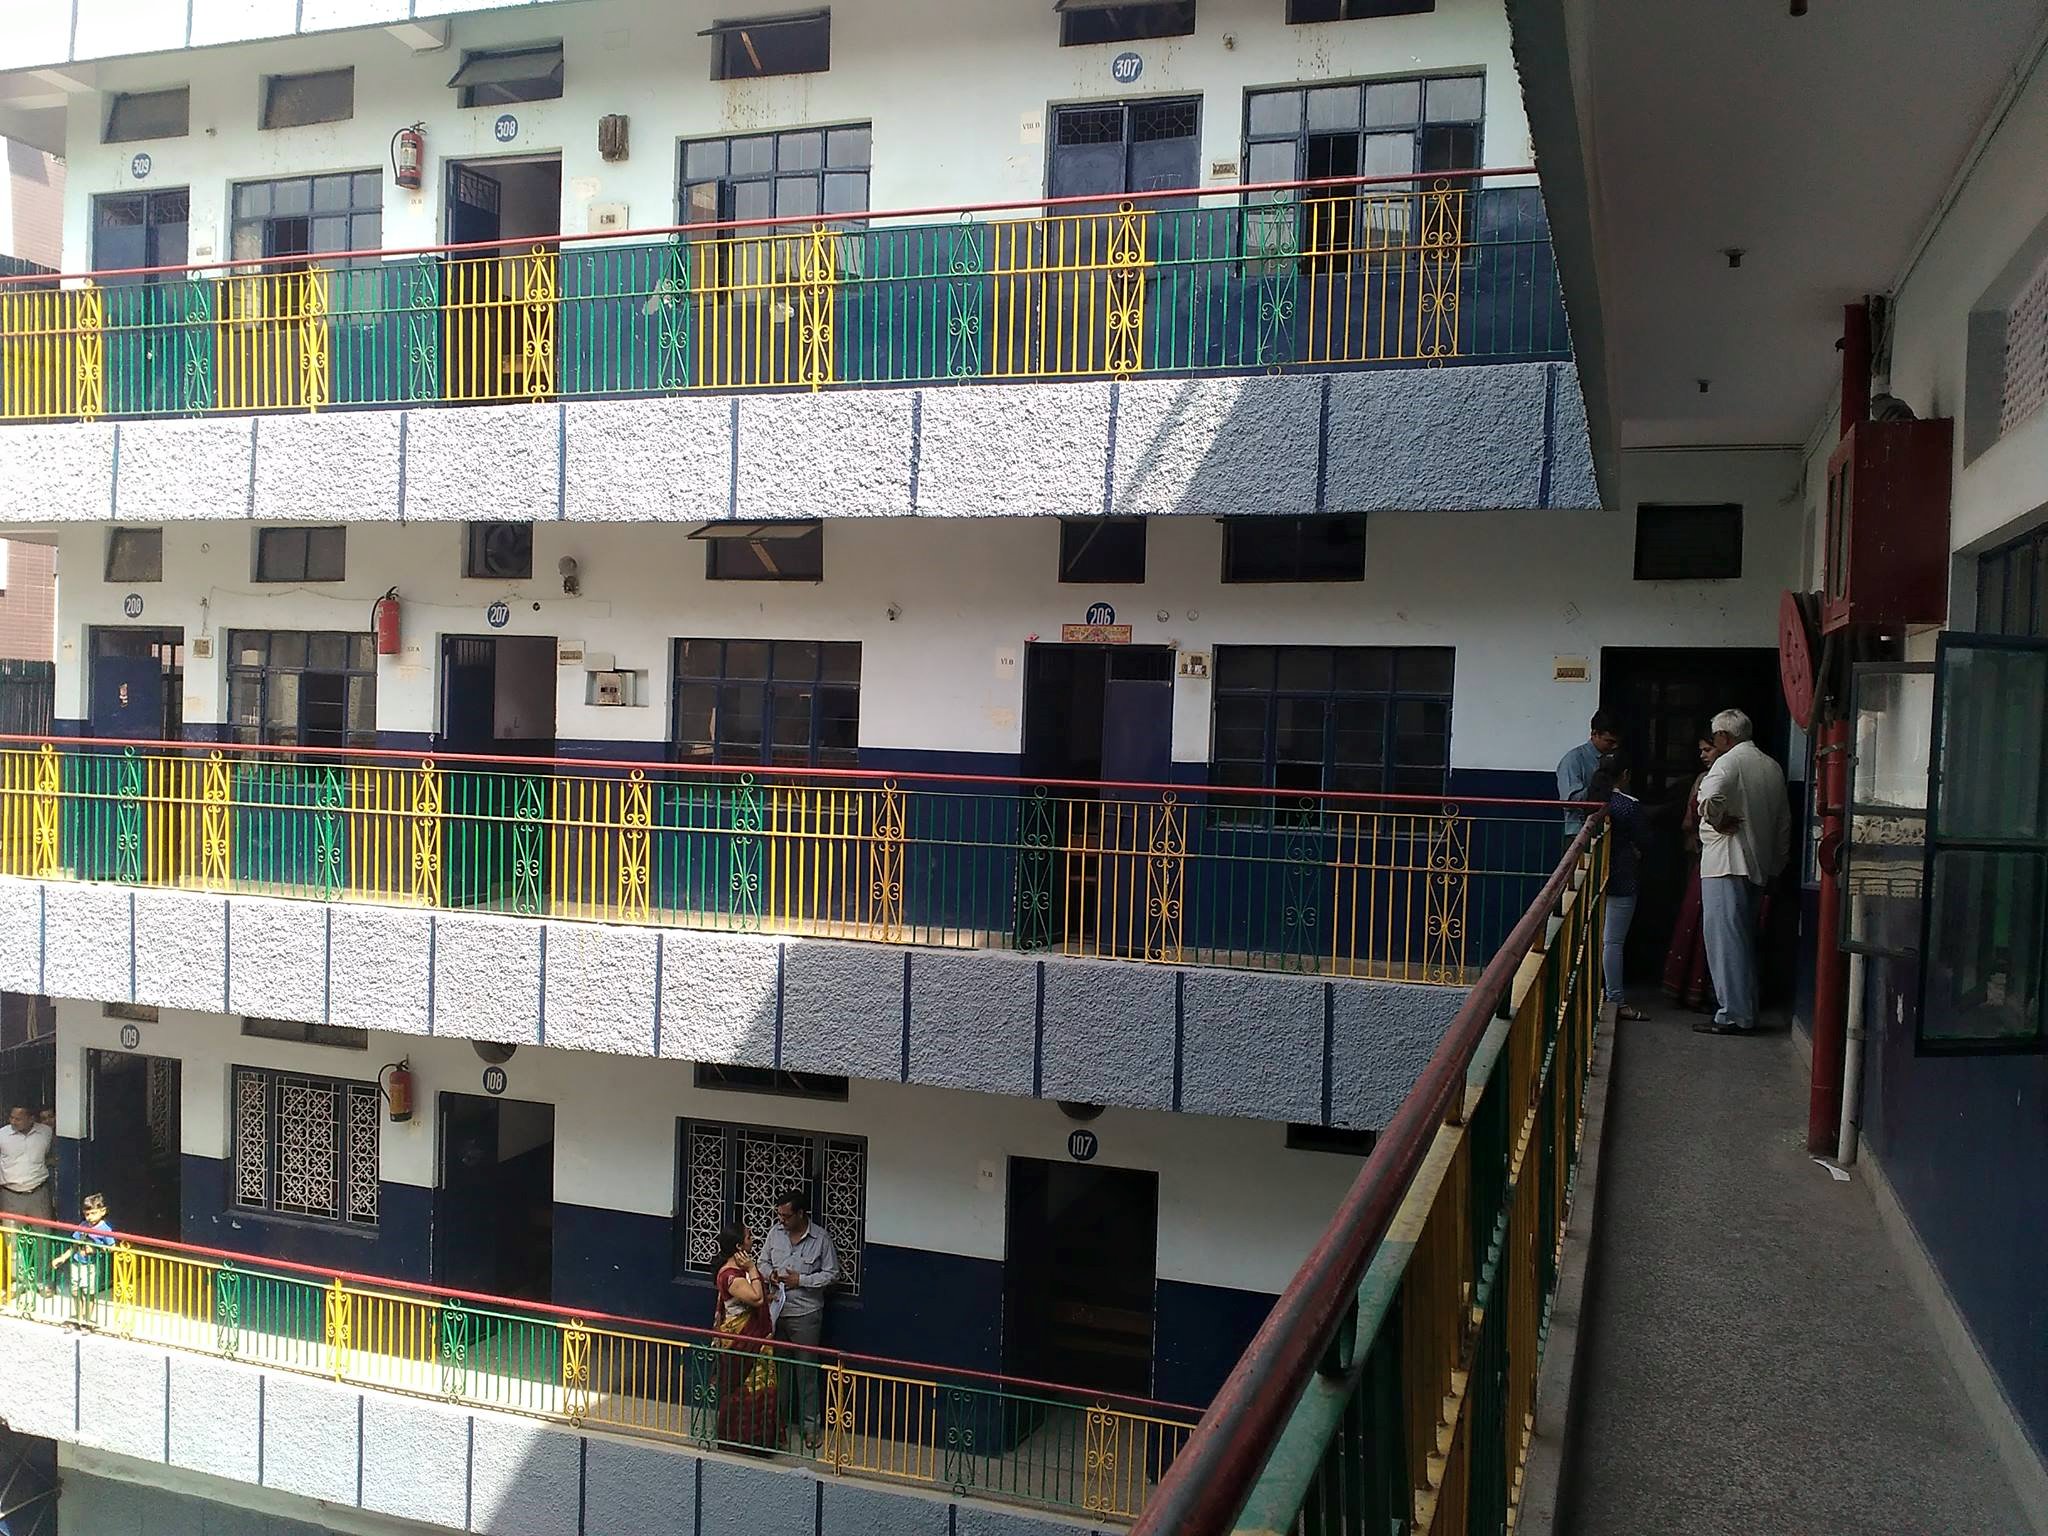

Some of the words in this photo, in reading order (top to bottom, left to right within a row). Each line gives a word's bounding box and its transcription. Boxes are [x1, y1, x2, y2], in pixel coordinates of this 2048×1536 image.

[1114, 58, 1139, 78] 307
[496, 120, 516, 138] 308
[133, 158, 150, 174] 309
[126, 598, 142, 615] 208
[490, 605, 507, 623] 207
[1090, 607, 1111, 625] 206
[123, 1028, 138, 1047] 109
[486, 1071, 503, 1091] 108
[1072, 1135, 1094, 1157] 107
